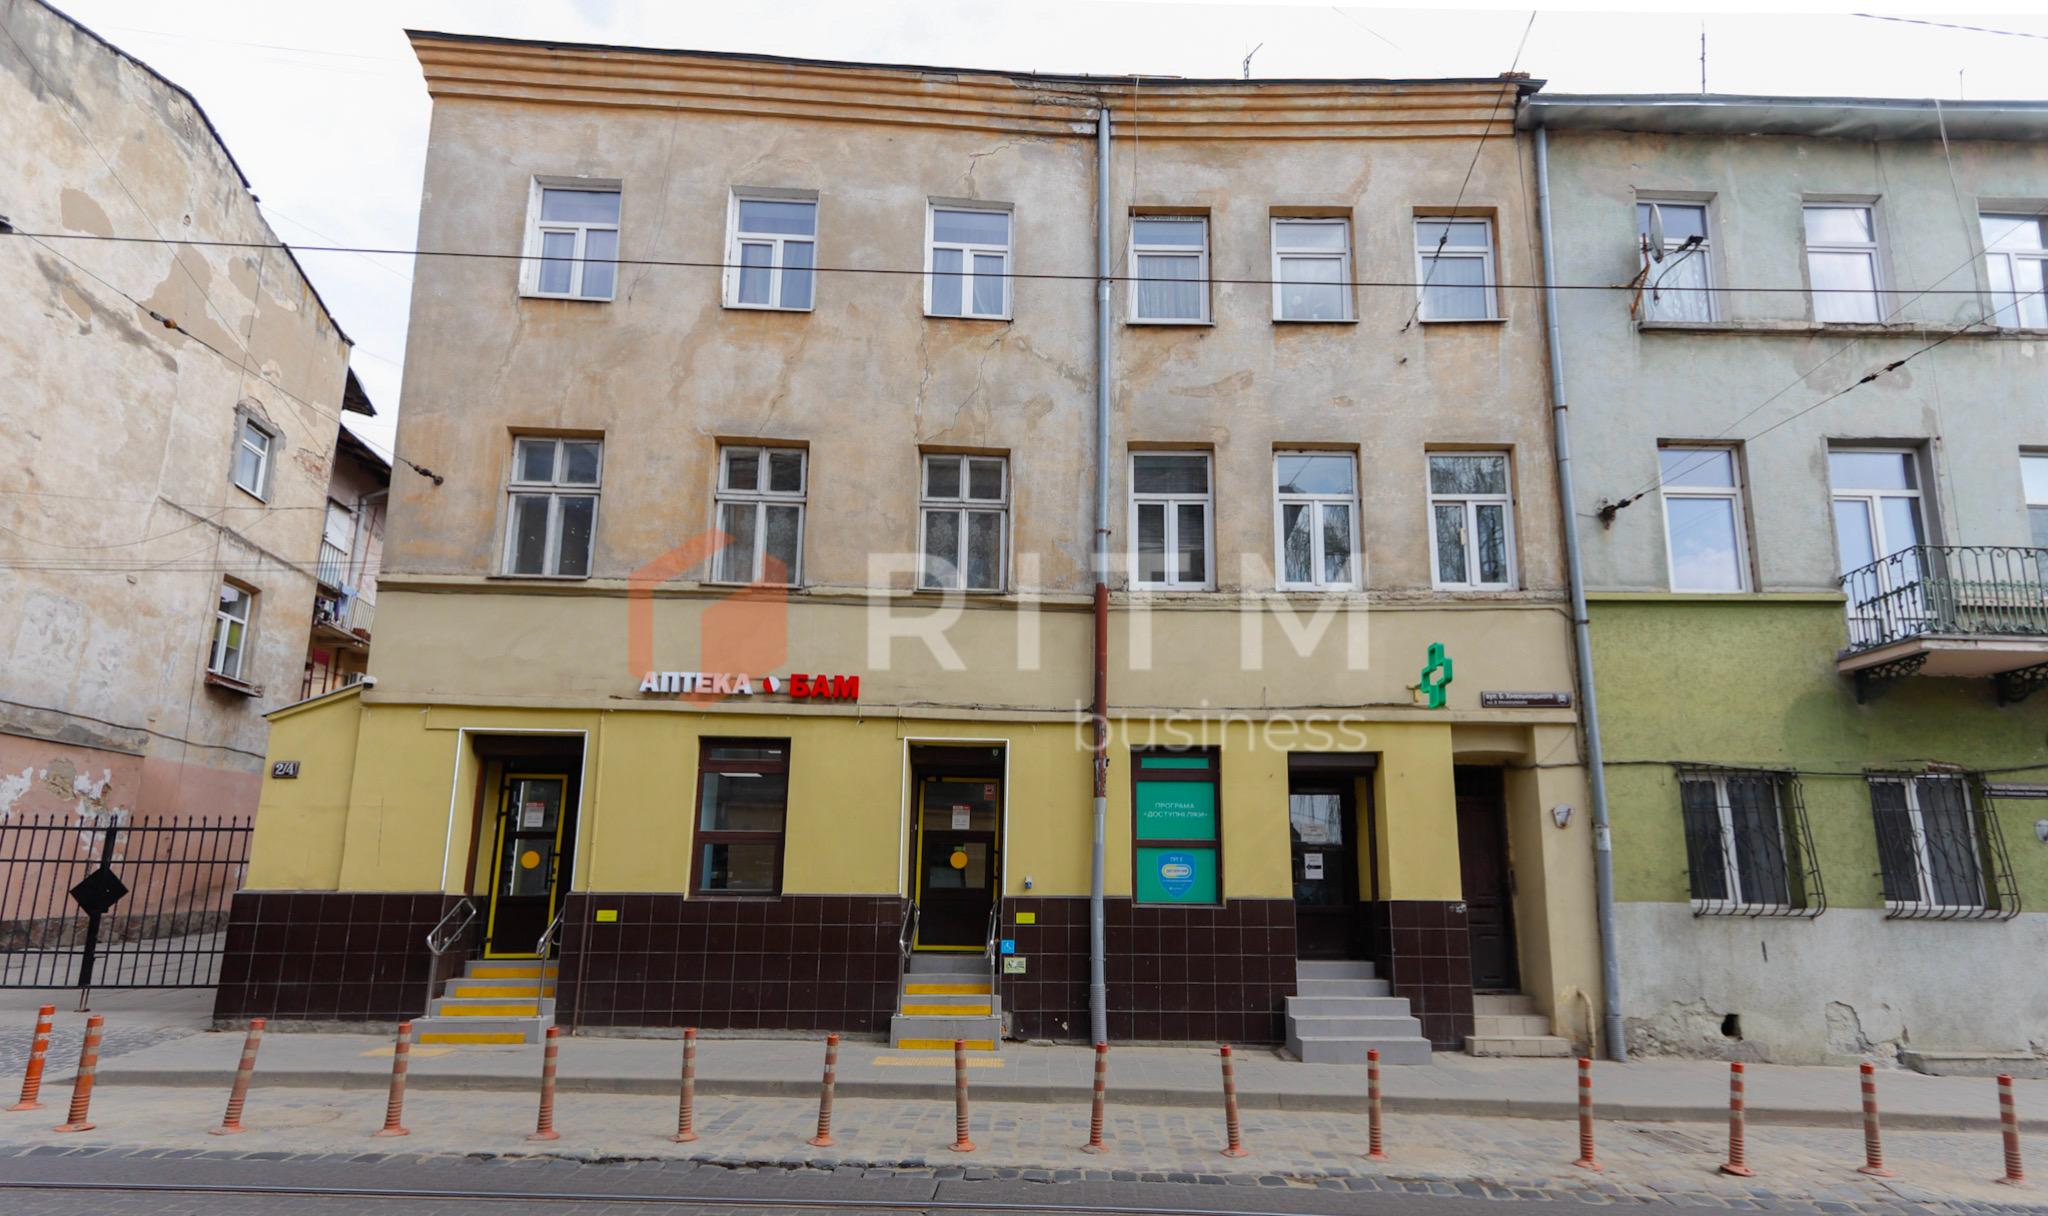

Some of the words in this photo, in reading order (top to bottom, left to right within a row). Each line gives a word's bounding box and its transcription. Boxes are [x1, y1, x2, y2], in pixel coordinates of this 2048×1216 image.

[639, 671, 753, 695] АПТЕКА
[789, 673, 860, 699] БАМ
[275, 762, 294, 776] 2/4
